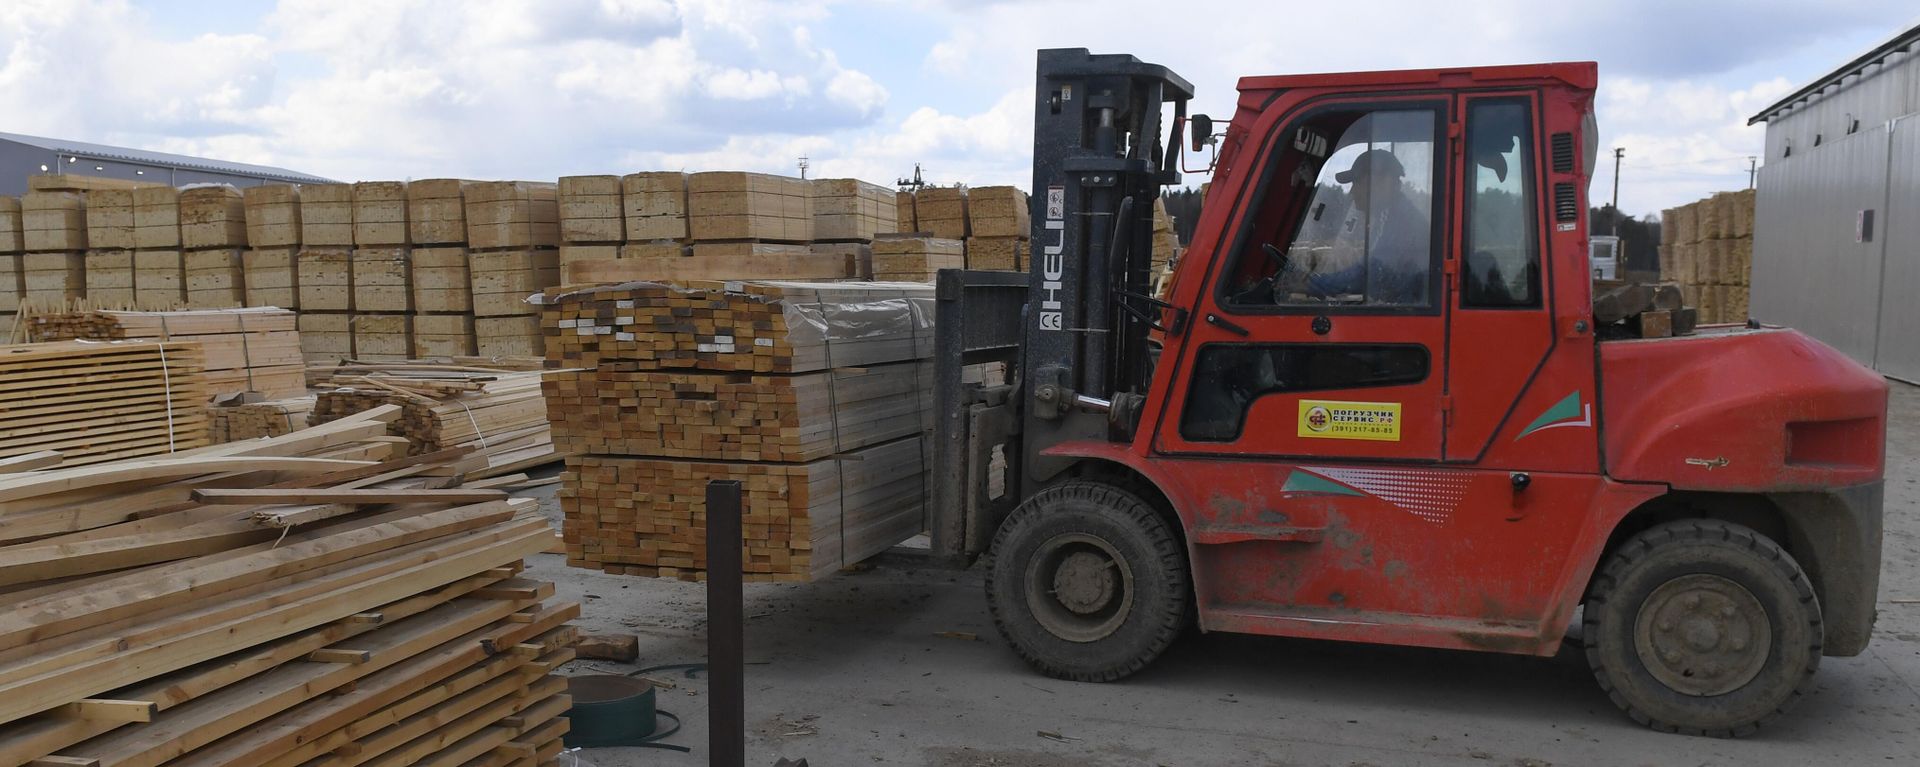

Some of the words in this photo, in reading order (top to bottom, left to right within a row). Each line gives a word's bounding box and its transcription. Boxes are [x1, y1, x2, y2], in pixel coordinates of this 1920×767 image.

[1042, 221, 1064, 310] HELI
[1041, 314, 1060, 329] CE
[1333, 409, 1394, 417] ПОГРУЗЧИК
